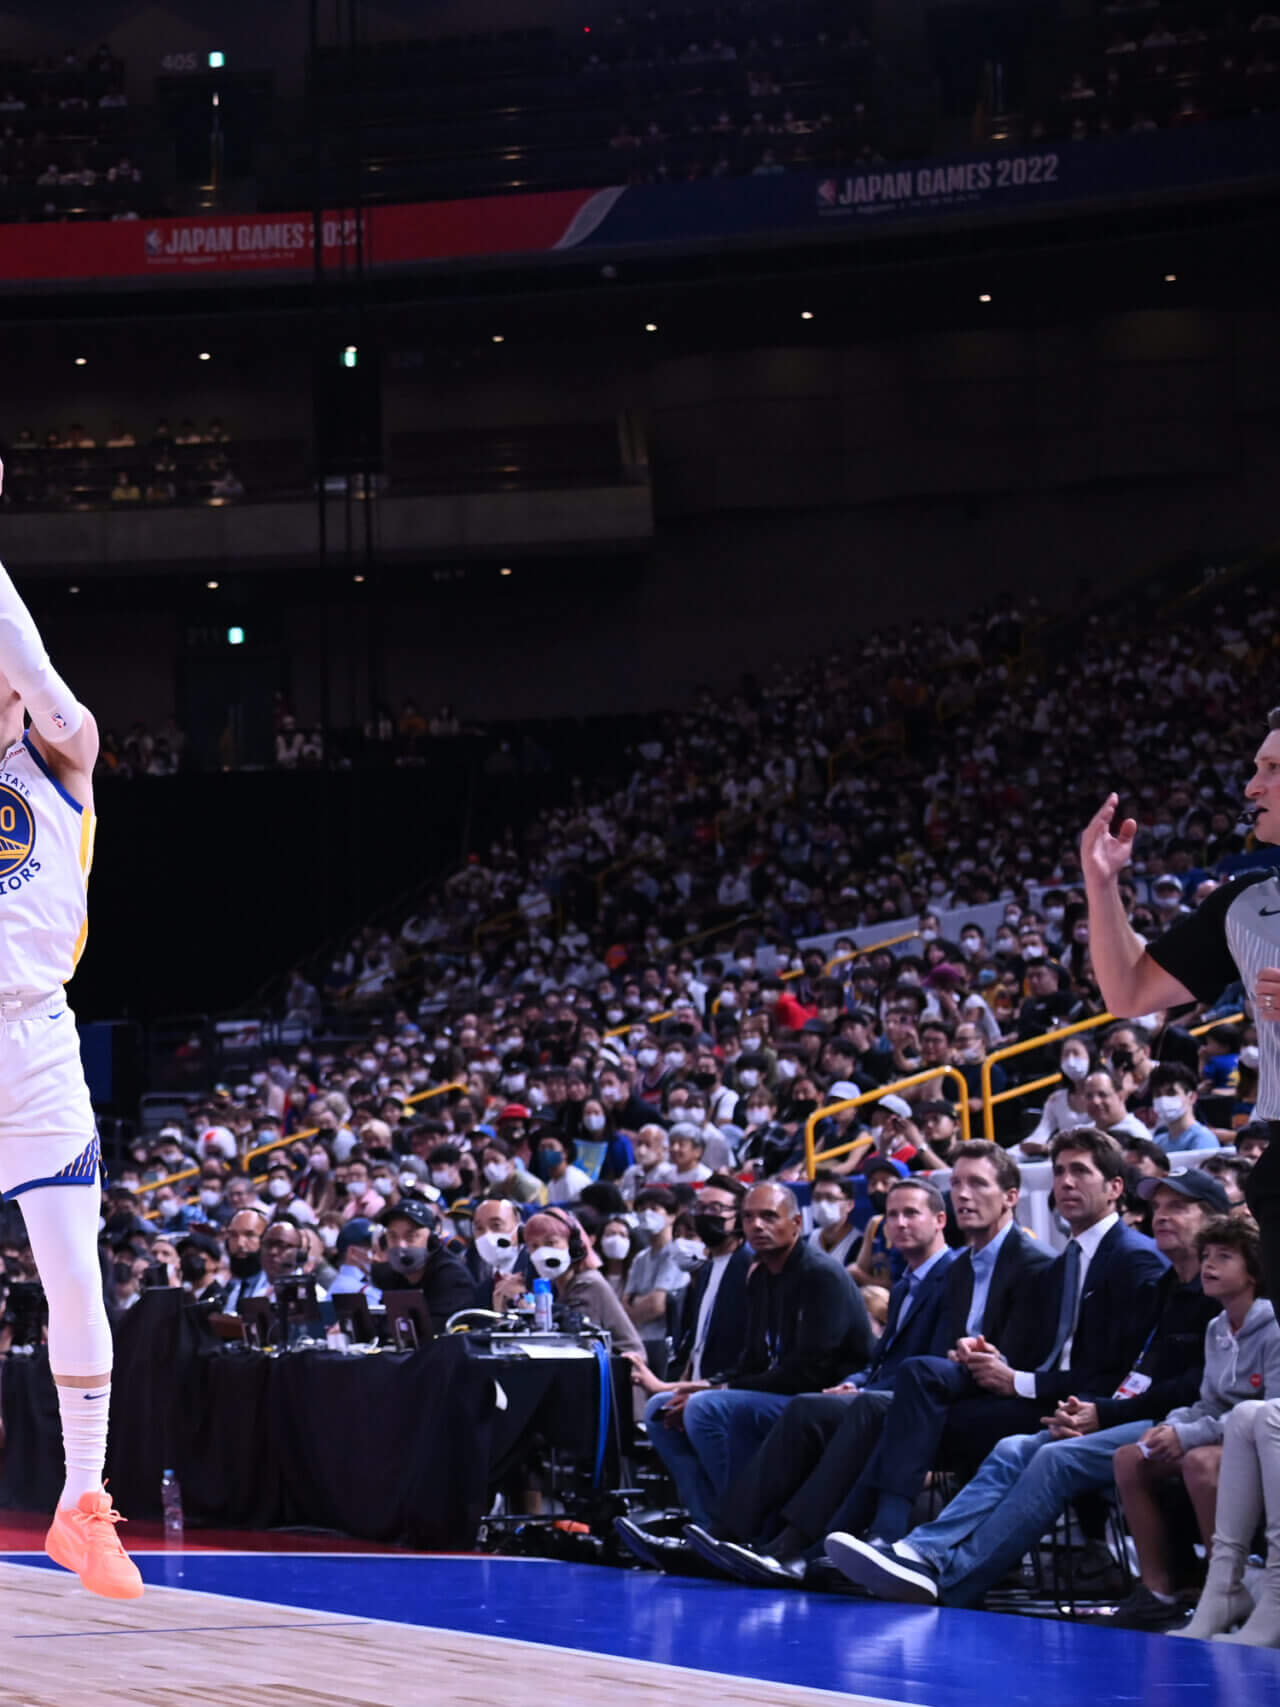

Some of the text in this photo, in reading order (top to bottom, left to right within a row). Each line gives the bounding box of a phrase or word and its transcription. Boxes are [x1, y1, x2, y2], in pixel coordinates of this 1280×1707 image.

[839, 171, 913, 205] JAPAN
[916, 161, 993, 196] GAMES
[995, 153, 1060, 188] 2022
[164, 226, 233, 254] JAPAN
[236, 222, 305, 251] GAMES
[0, 805, 16, 832] 0
